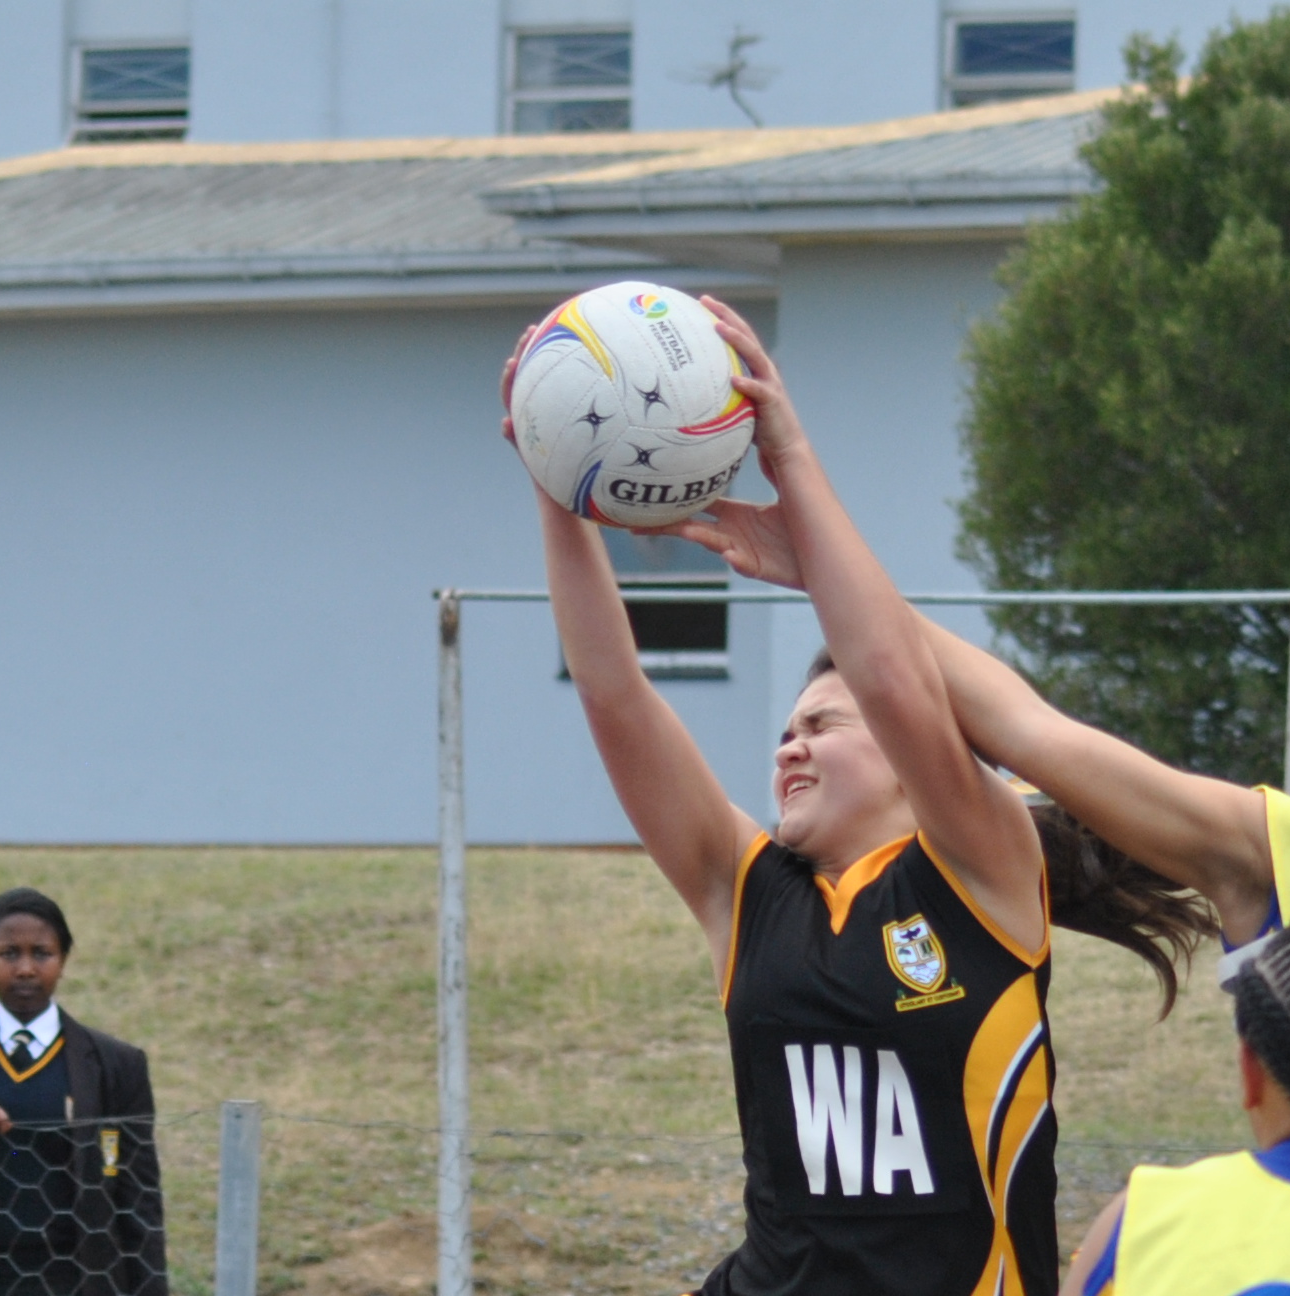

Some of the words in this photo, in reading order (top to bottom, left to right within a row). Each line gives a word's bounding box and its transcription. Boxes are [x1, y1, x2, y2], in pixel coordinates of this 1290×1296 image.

[649, 324, 679, 371] FEDERATION
[656, 321, 688, 369] NETBALL
[784, 1044, 935, 1196] WA
